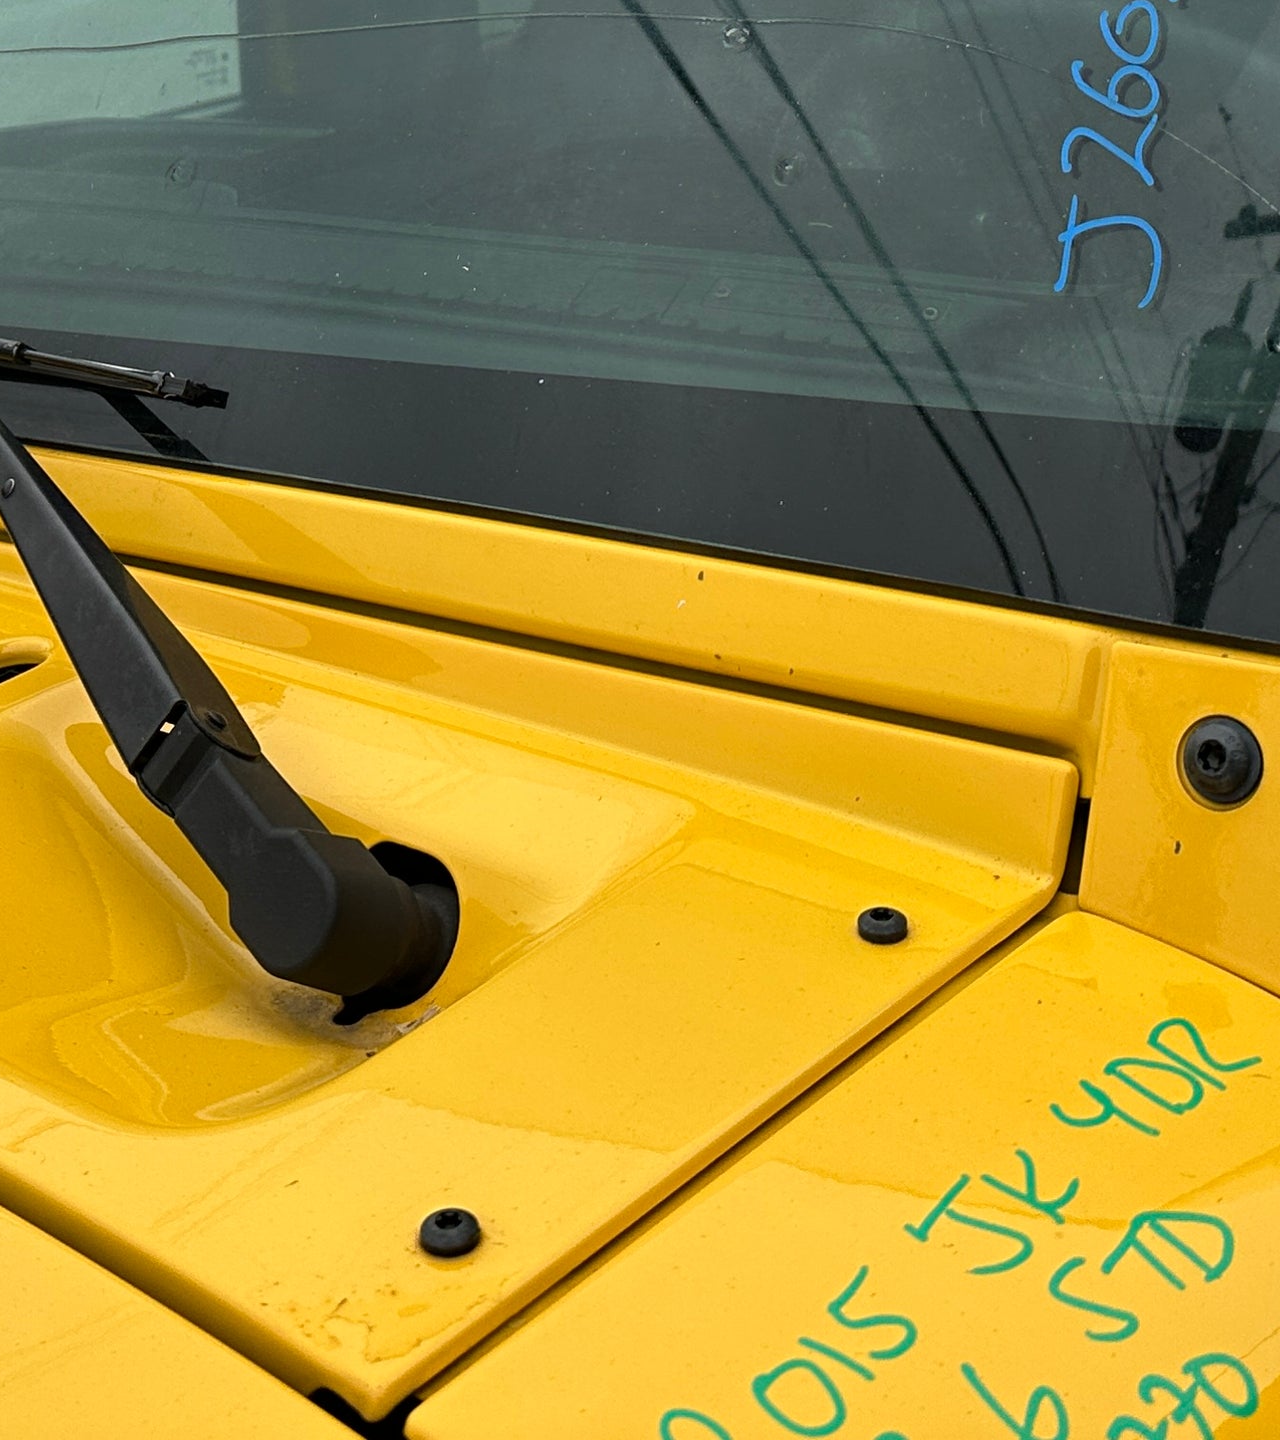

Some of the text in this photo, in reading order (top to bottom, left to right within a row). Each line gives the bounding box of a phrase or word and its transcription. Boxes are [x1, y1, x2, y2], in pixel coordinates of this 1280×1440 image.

[904, 1148, 1081, 1274] JK
[1049, 1017, 1263, 1137] 4DR
[1048, 1209, 1235, 1342] STD
